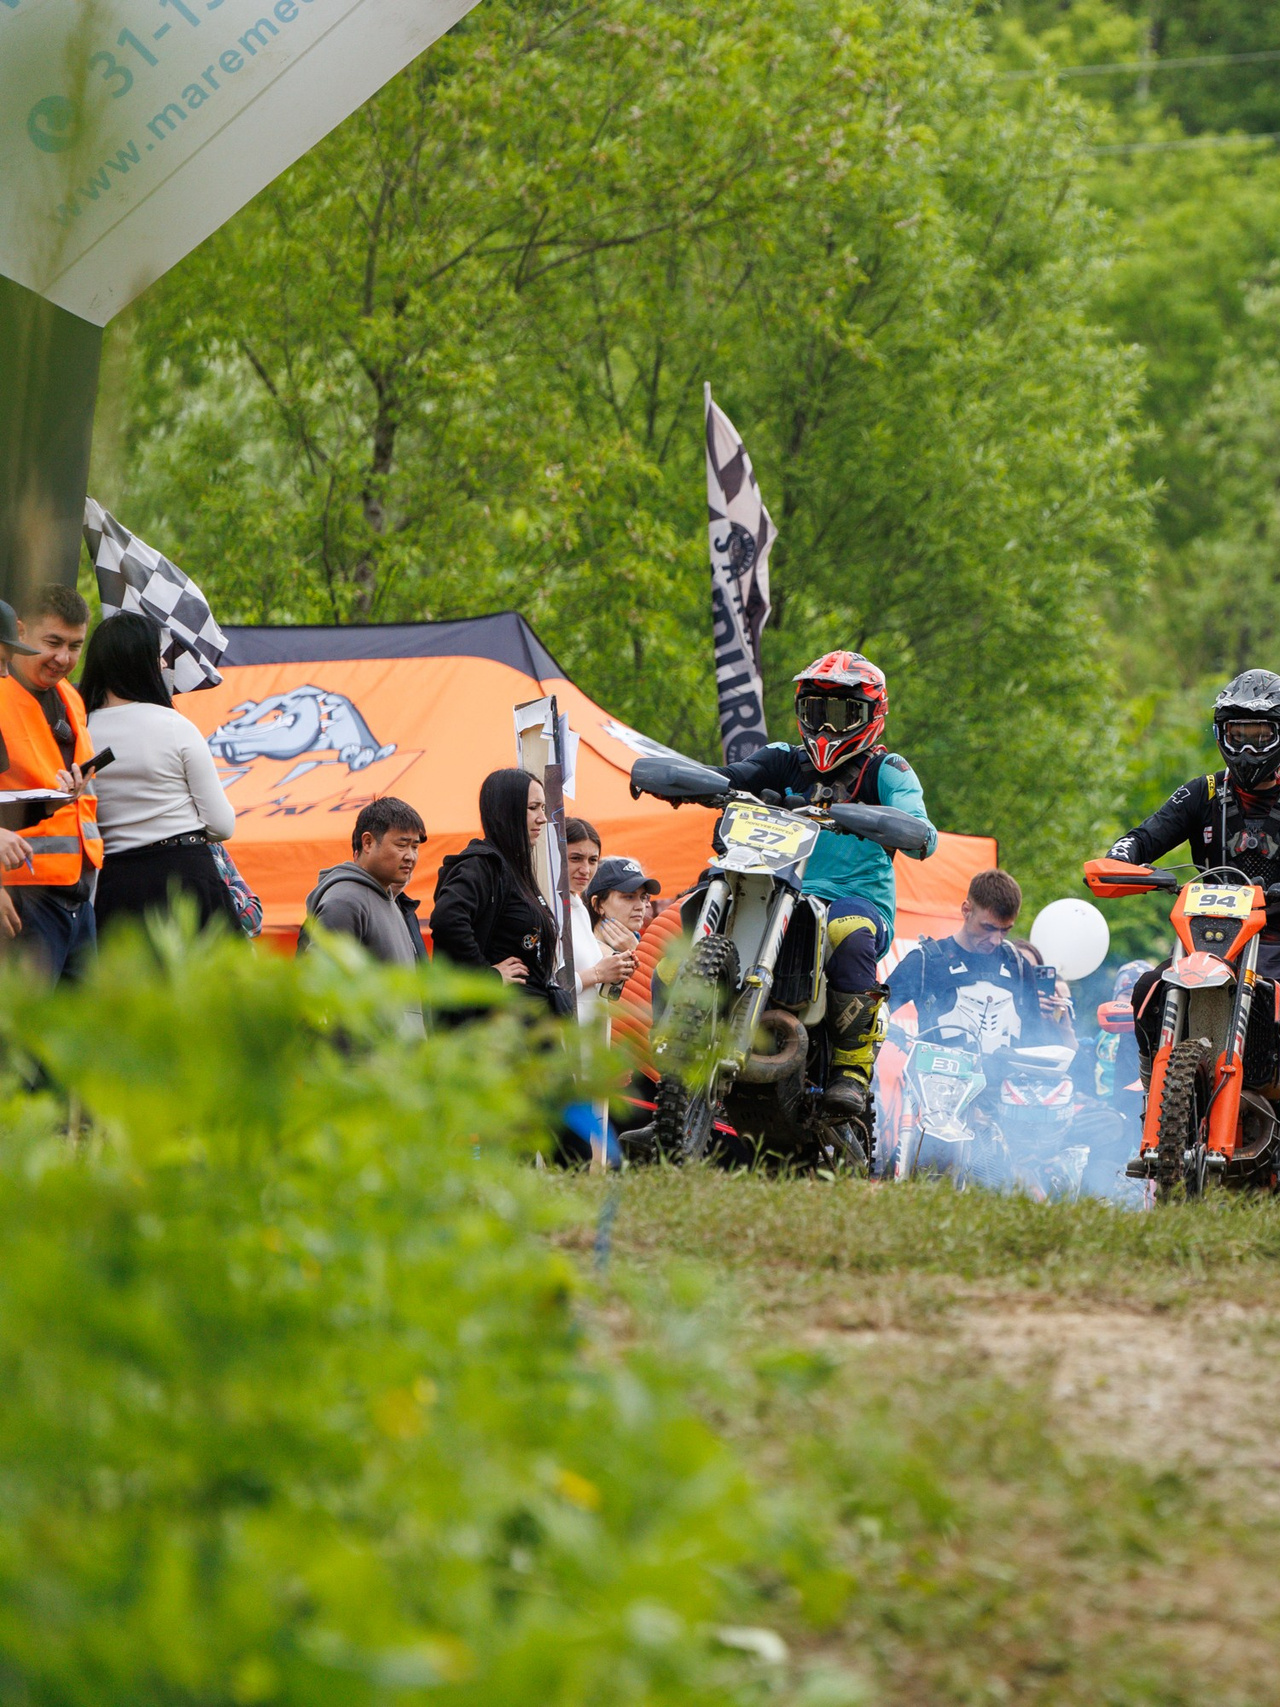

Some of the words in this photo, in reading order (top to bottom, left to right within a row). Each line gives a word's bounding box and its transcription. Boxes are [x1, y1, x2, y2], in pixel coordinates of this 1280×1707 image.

[748, 828, 786, 845] 27
[1198, 894, 1236, 908] 94
[932, 1057, 959, 1073] 31
